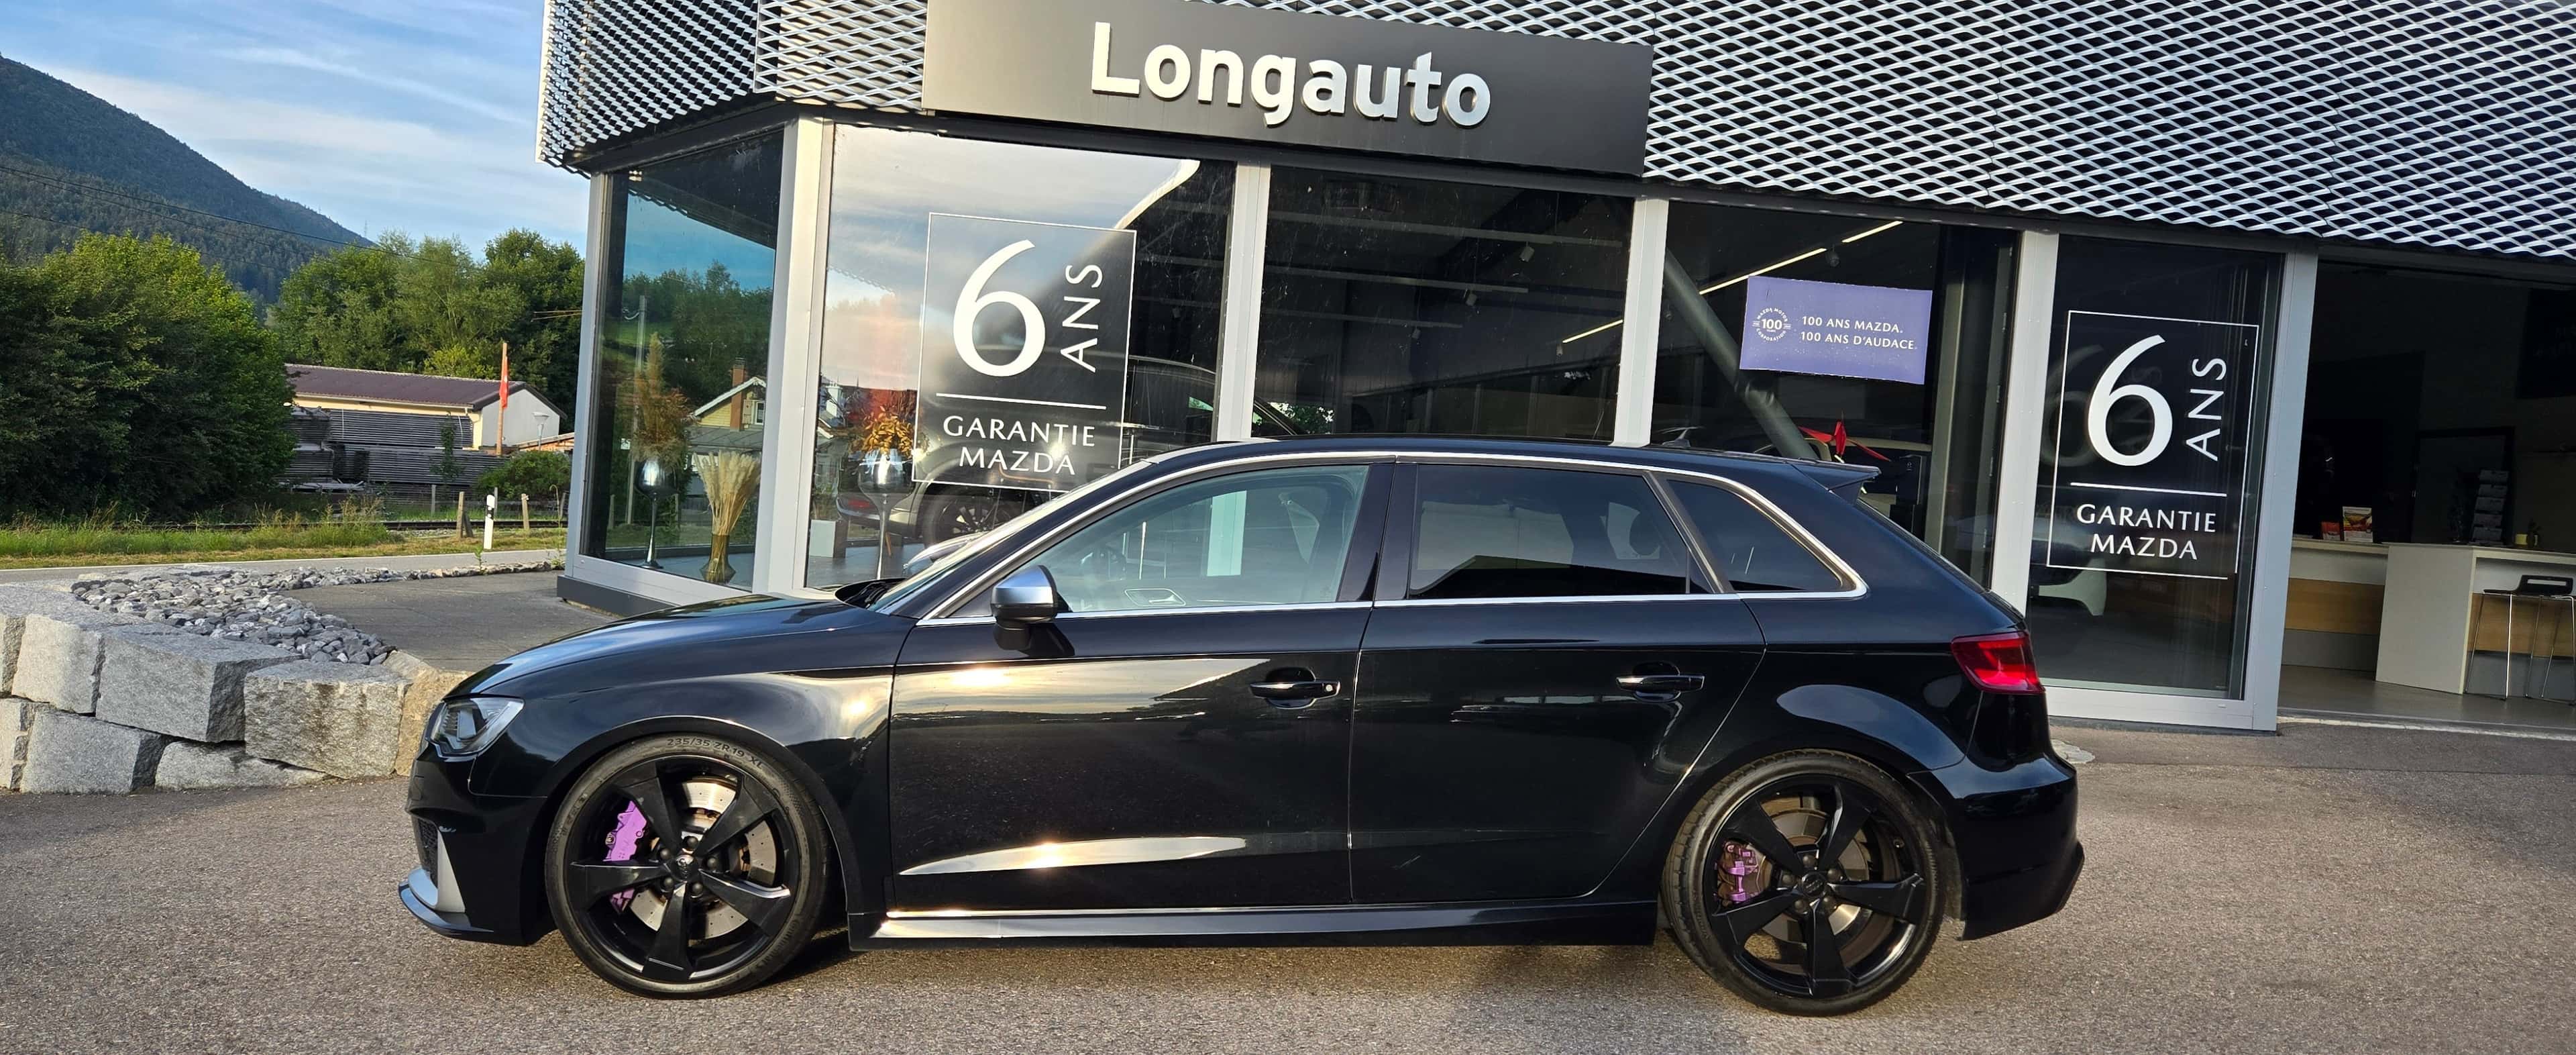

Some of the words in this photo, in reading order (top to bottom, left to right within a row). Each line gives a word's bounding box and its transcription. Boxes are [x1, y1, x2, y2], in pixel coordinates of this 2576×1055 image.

[1091, 21, 1491, 128] Longauto
[953, 239, 1046, 377] 6
[1060, 264, 1104, 373] ANS
[1761, 319, 1782, 330] 100
[1801, 332, 1821, 342] 100
[1825, 334, 1849, 344] ANS
[1802, 315, 1823, 327] 100
[1827, 319, 1851, 329] ANS
[1854, 320, 1904, 334] MAZDA.
[2088, 334, 2173, 466] 6
[2186, 358, 2226, 462] ANS
[943, 415, 1095, 447] GARANTIE
[959, 446, 1076, 475] MAZDA
[2076, 503, 2216, 533] GARANTIE
[2090, 534, 2198, 560] MAZDA
[667, 738, 710, 747] 235/35
